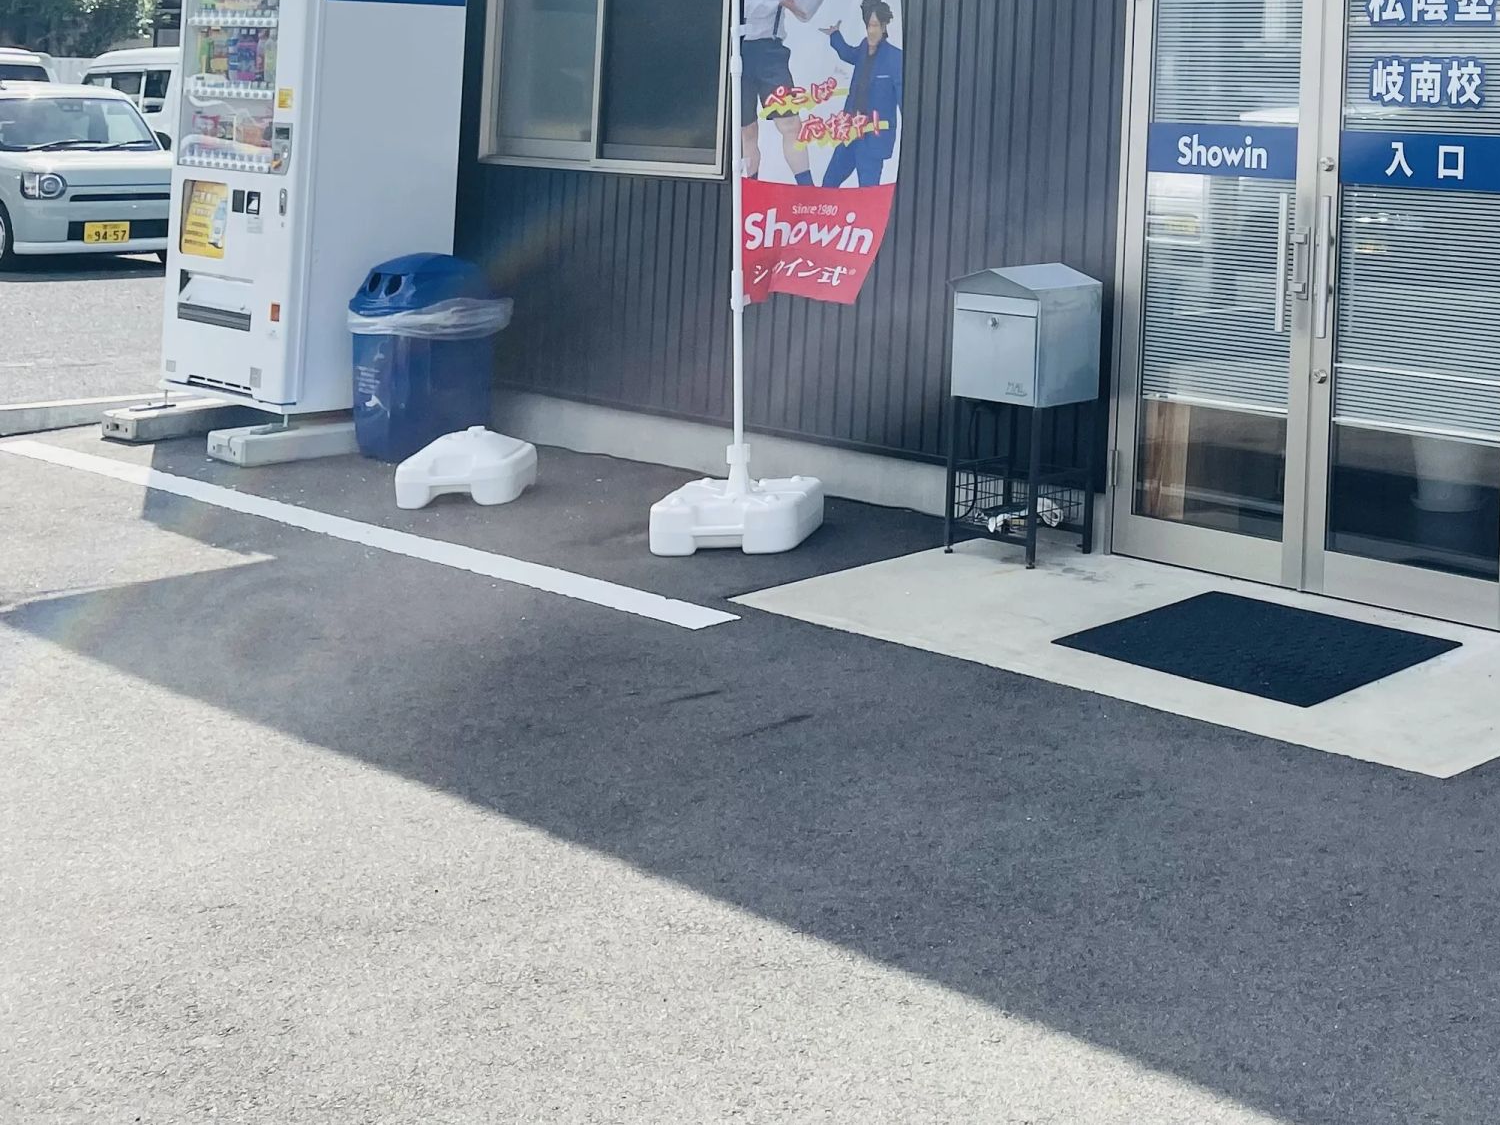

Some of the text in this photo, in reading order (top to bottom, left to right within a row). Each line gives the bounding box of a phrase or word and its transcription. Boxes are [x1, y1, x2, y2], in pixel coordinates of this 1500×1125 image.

[1372, 60, 1482, 105] 岐南校
[1177, 134, 1267, 170] Showin
[817, 204, 838, 216] 1980
[744, 208, 874, 255] Showin
